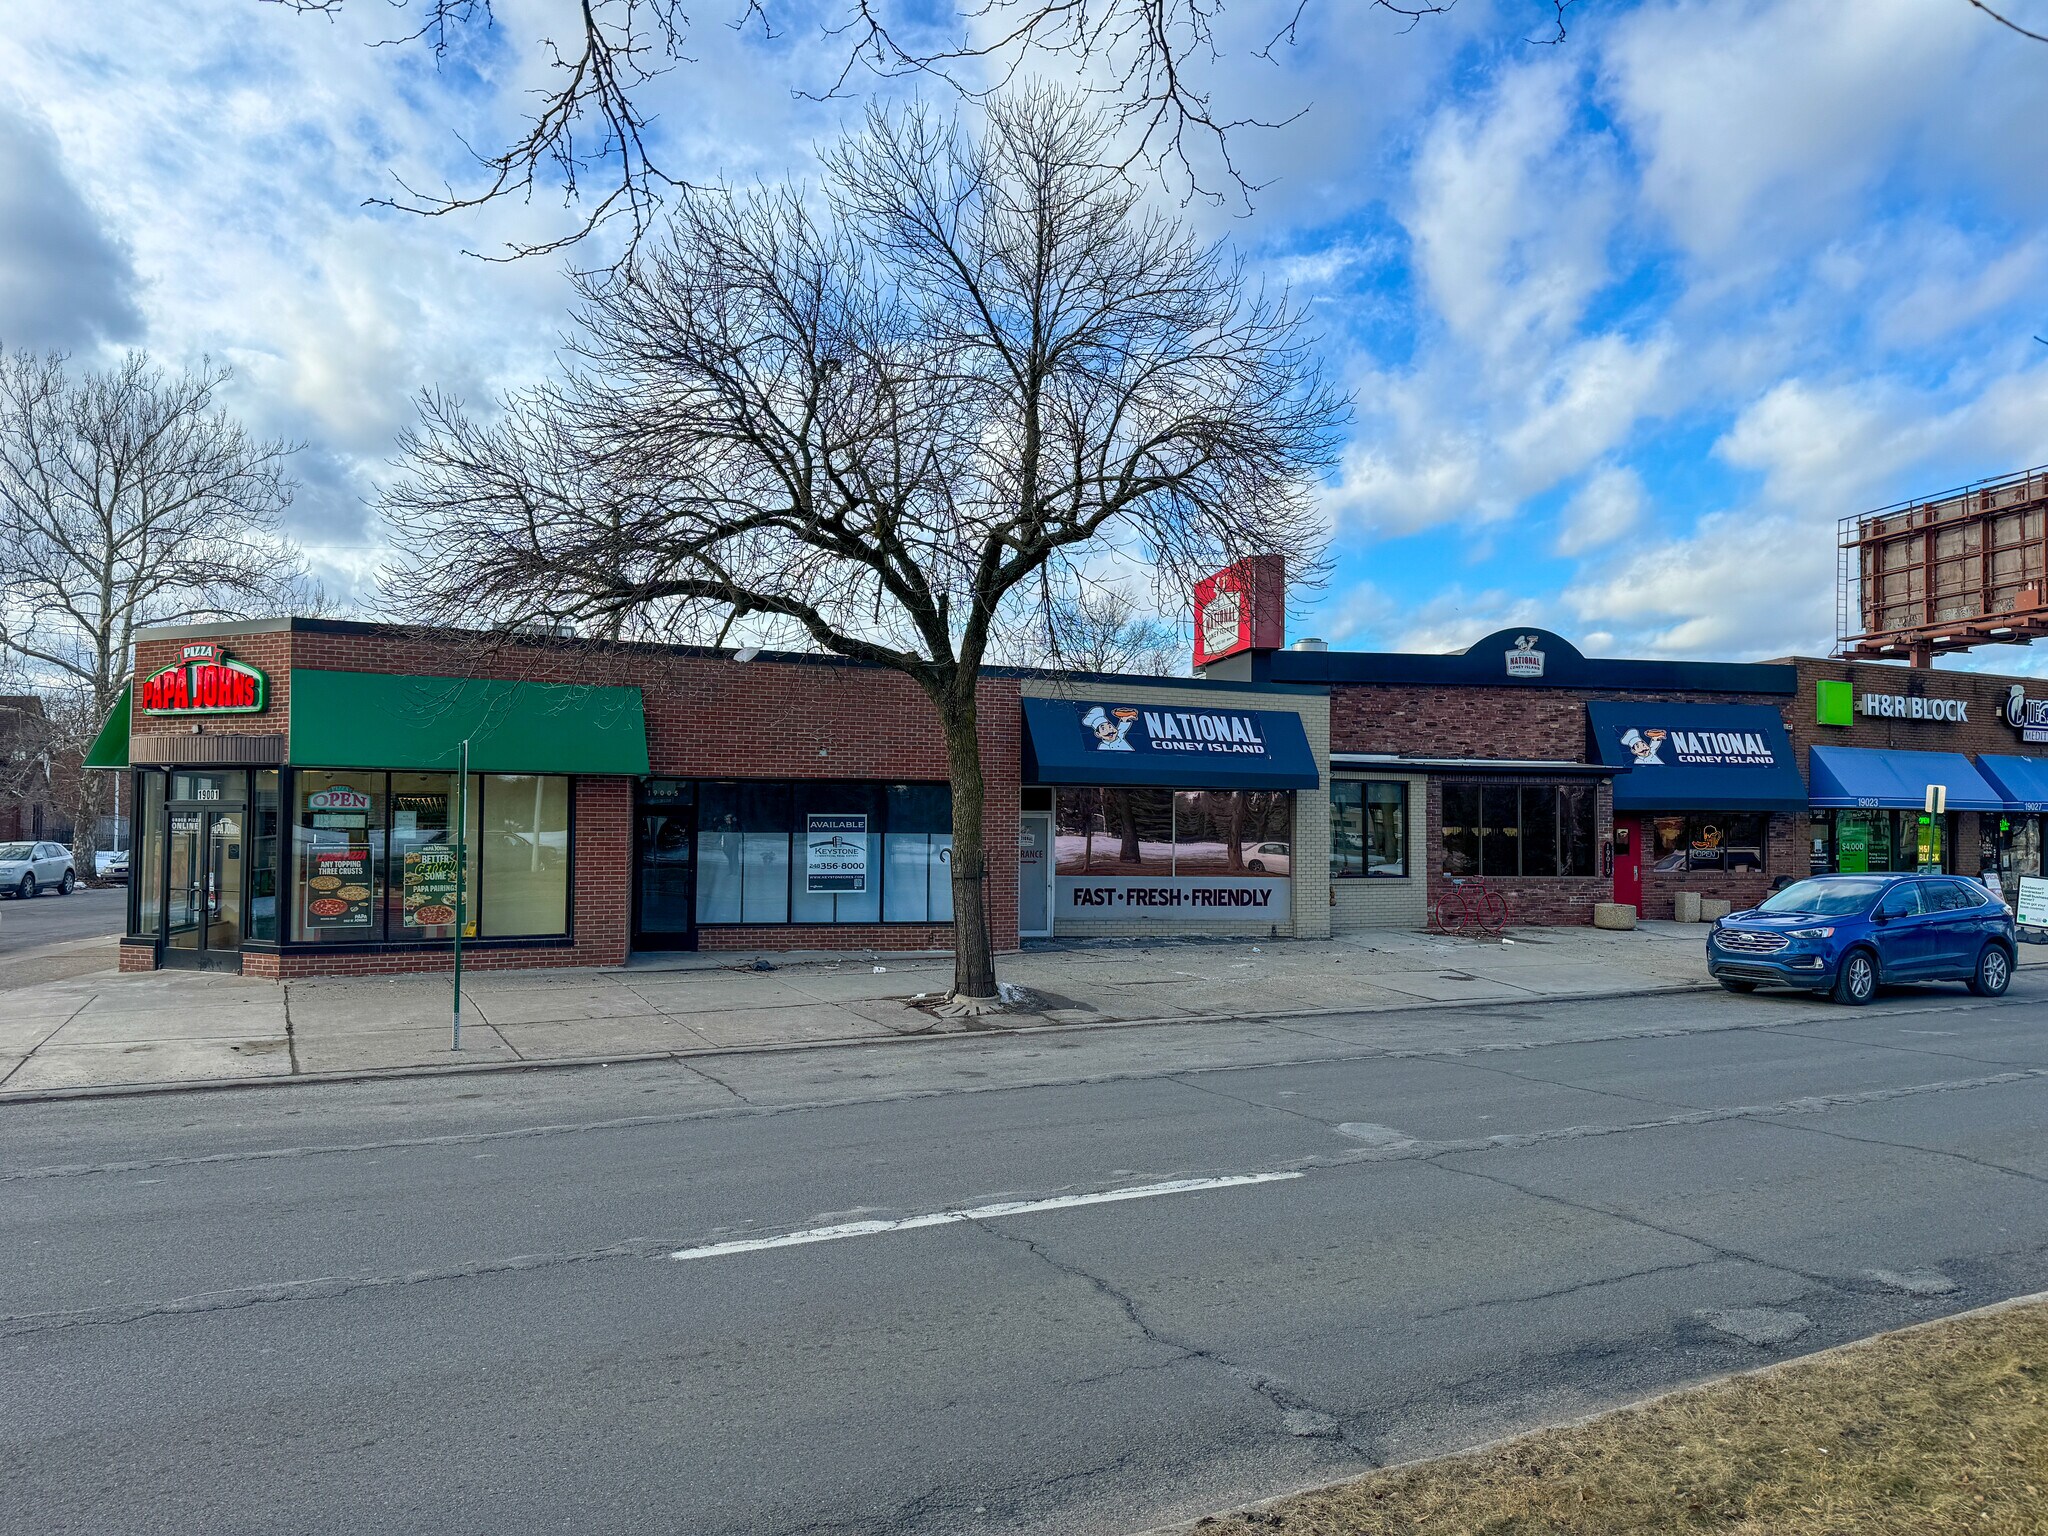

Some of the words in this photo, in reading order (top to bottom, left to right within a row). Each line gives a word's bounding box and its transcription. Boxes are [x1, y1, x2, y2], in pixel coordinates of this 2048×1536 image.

[183, 646, 212, 658] PIZZA
[1510, 656, 1541, 667] NATIONAL
[142, 667, 189, 709] PAPA
[1862, 693, 1907, 718] H&R
[1911, 697, 1969, 722] BLOCK
[1143, 711, 1262, 743] NATIONAL
[1151, 740, 1204, 751] CONEY
[1207, 743, 1265, 754] ISLAND
[1670, 731, 1772, 755] NATIONAL
[1678, 755, 1723, 763] CONEY
[1725, 756, 1775, 764] ISLAND
[198, 790, 220, 800] 19001
[312, 793, 368, 808] OPEN
[1857, 798, 1879, 807] 19023
[2024, 802, 2042, 810] 19027
[810, 821, 865, 829] AVAILABLE
[815, 847, 859, 855] KEYSTONE
[1841, 842, 1864, 851] $4,000
[1020, 850, 1044, 858] RANCE
[1695, 850, 1716, 858] OPEN
[421, 854, 449, 864] BETTER
[335, 860, 361, 868] TOPPING
[820, 862, 865, 870] 356-8000
[318, 867, 339, 875] THREE
[339, 867, 363, 875] CRUSTS
[424, 872, 447, 881] SOME
[412, 885, 430, 893] PAPA
[429, 884, 457, 892] PAIRINGS
[1073, 887, 1117, 906] FAST
[1126, 887, 1182, 907] FRESH
[1191, 888, 1273, 907] FRIENDLY
